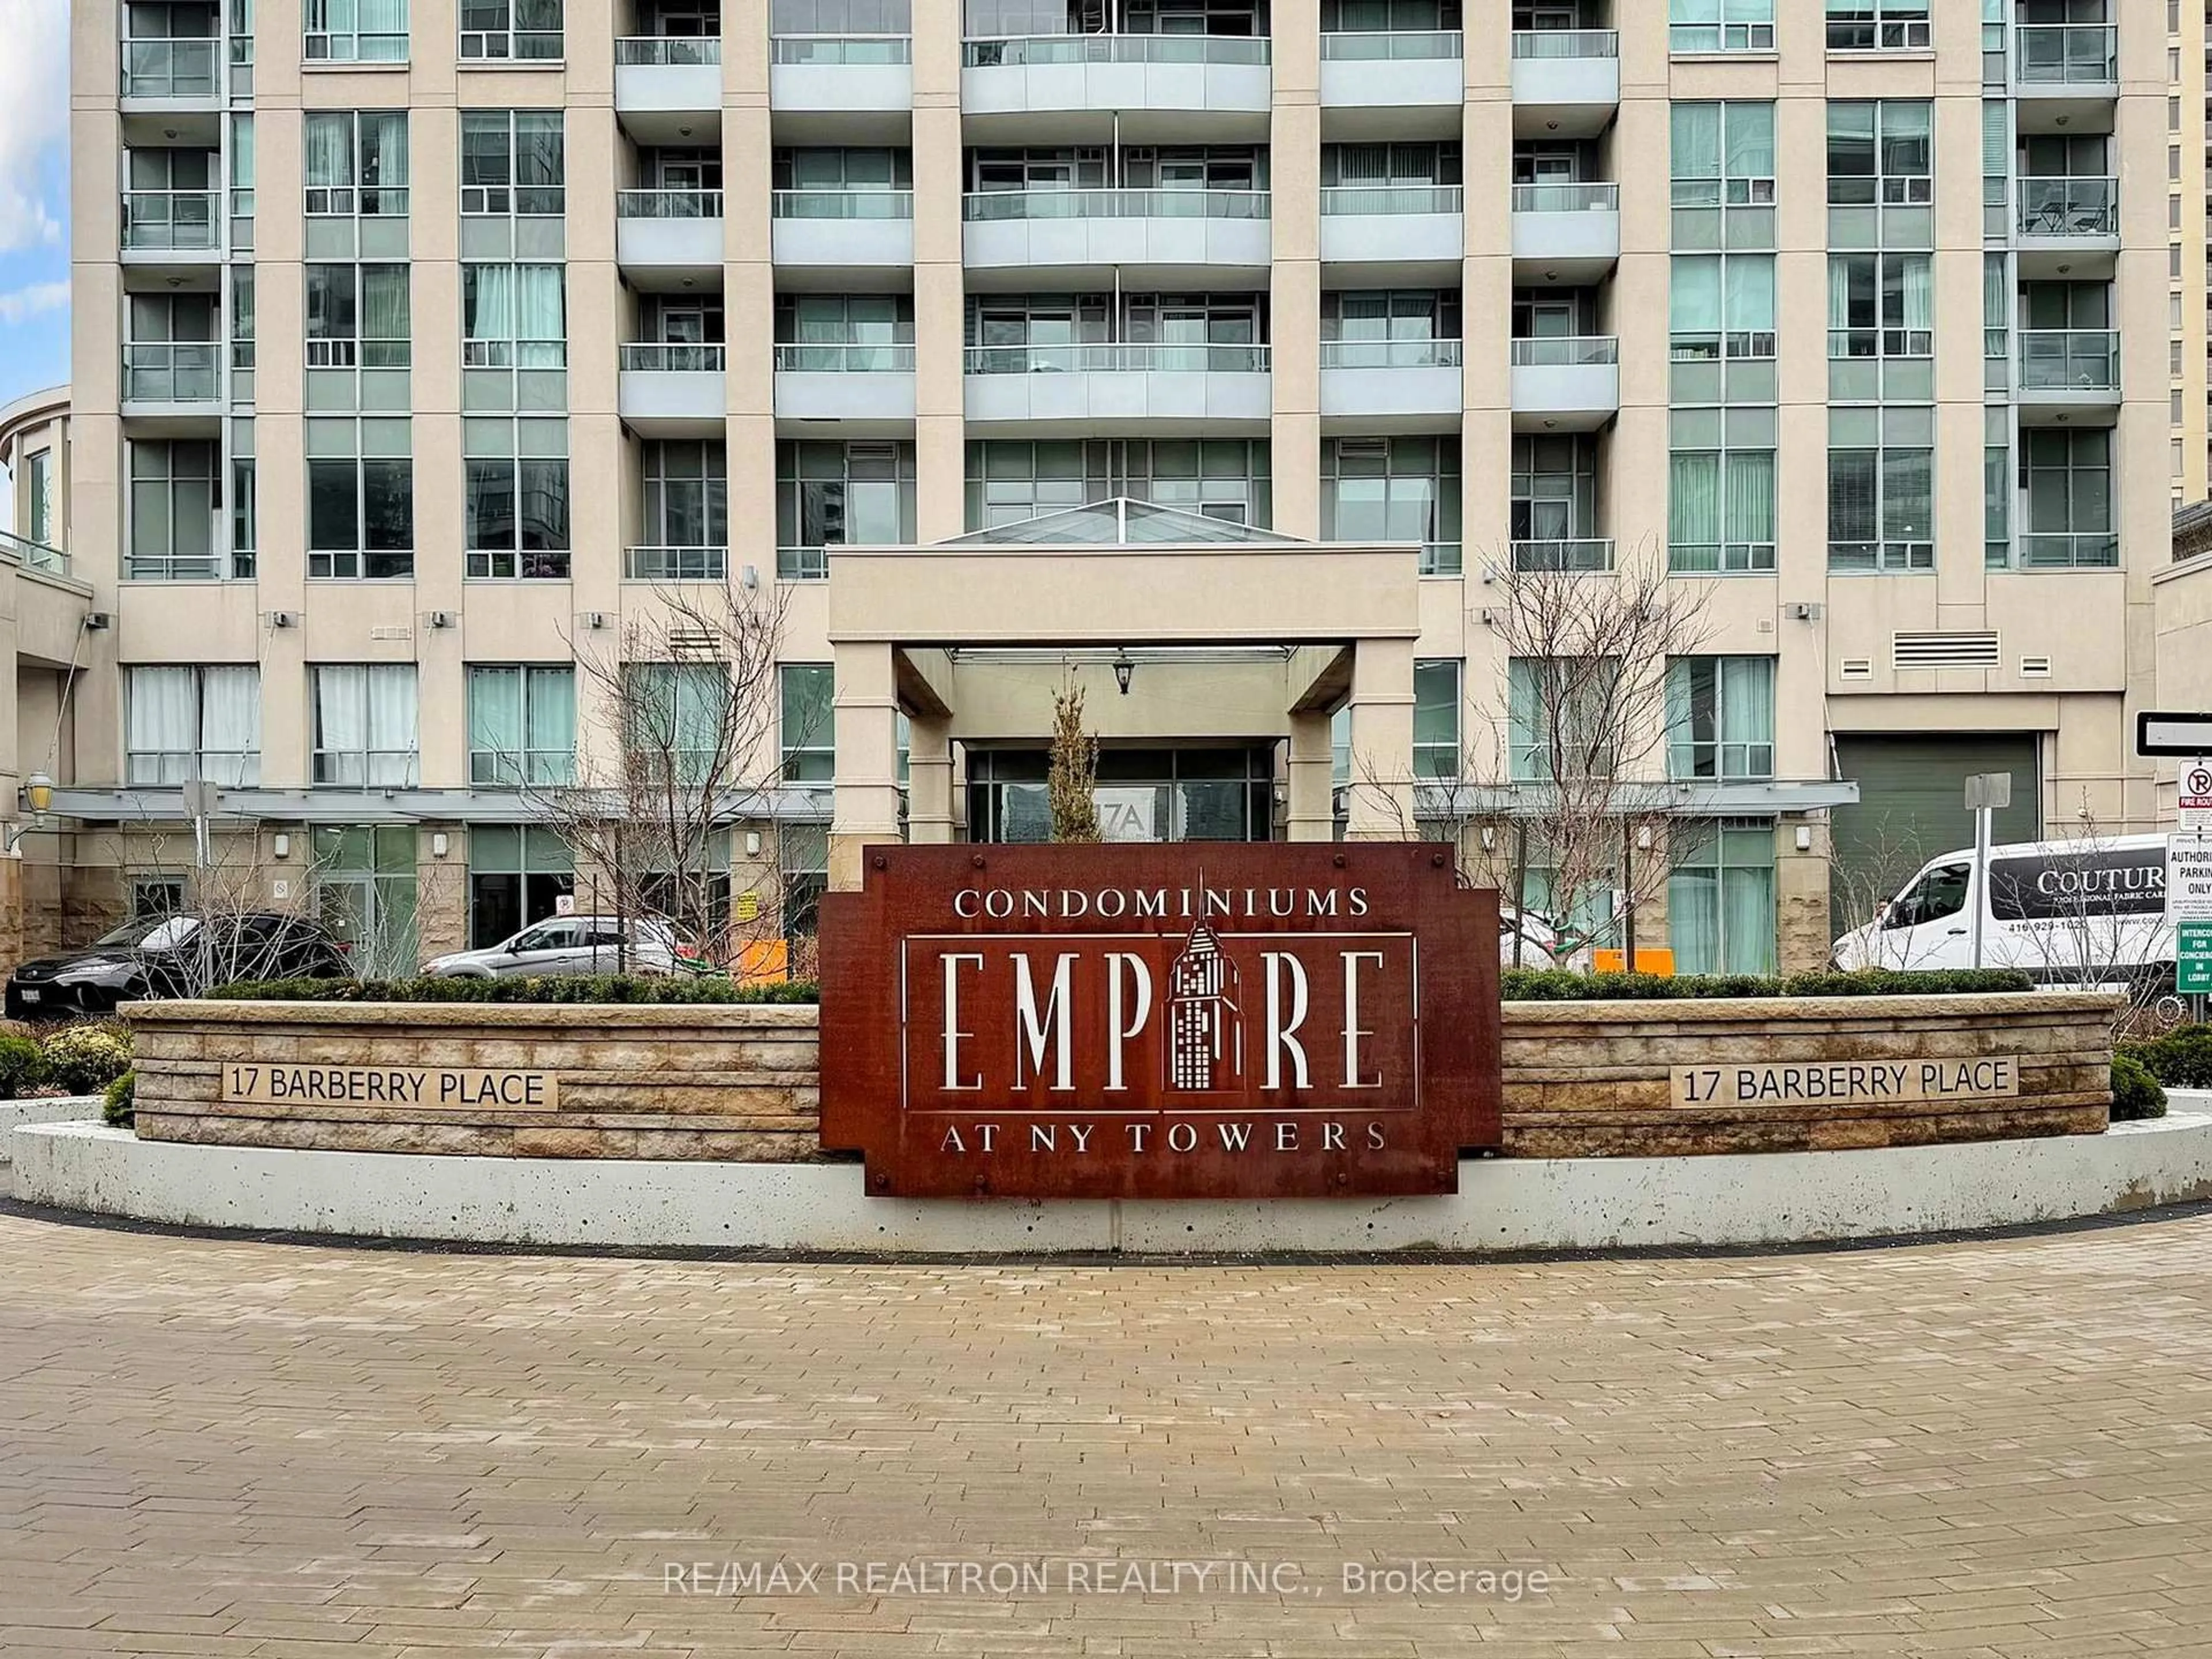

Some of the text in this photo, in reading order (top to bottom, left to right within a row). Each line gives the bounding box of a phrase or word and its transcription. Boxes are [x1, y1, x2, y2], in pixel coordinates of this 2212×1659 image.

[953, 887, 1370, 918] CONDOMINIUMS
[2188, 883, 2211, 894] ONLY
[232, 1067, 544, 1104] 17 BARBERRY PLACE
[1684, 1062, 2009, 1101] 17 BARBERRY PLACE
[940, 1122, 1384, 1152] AT NY TOWERS
